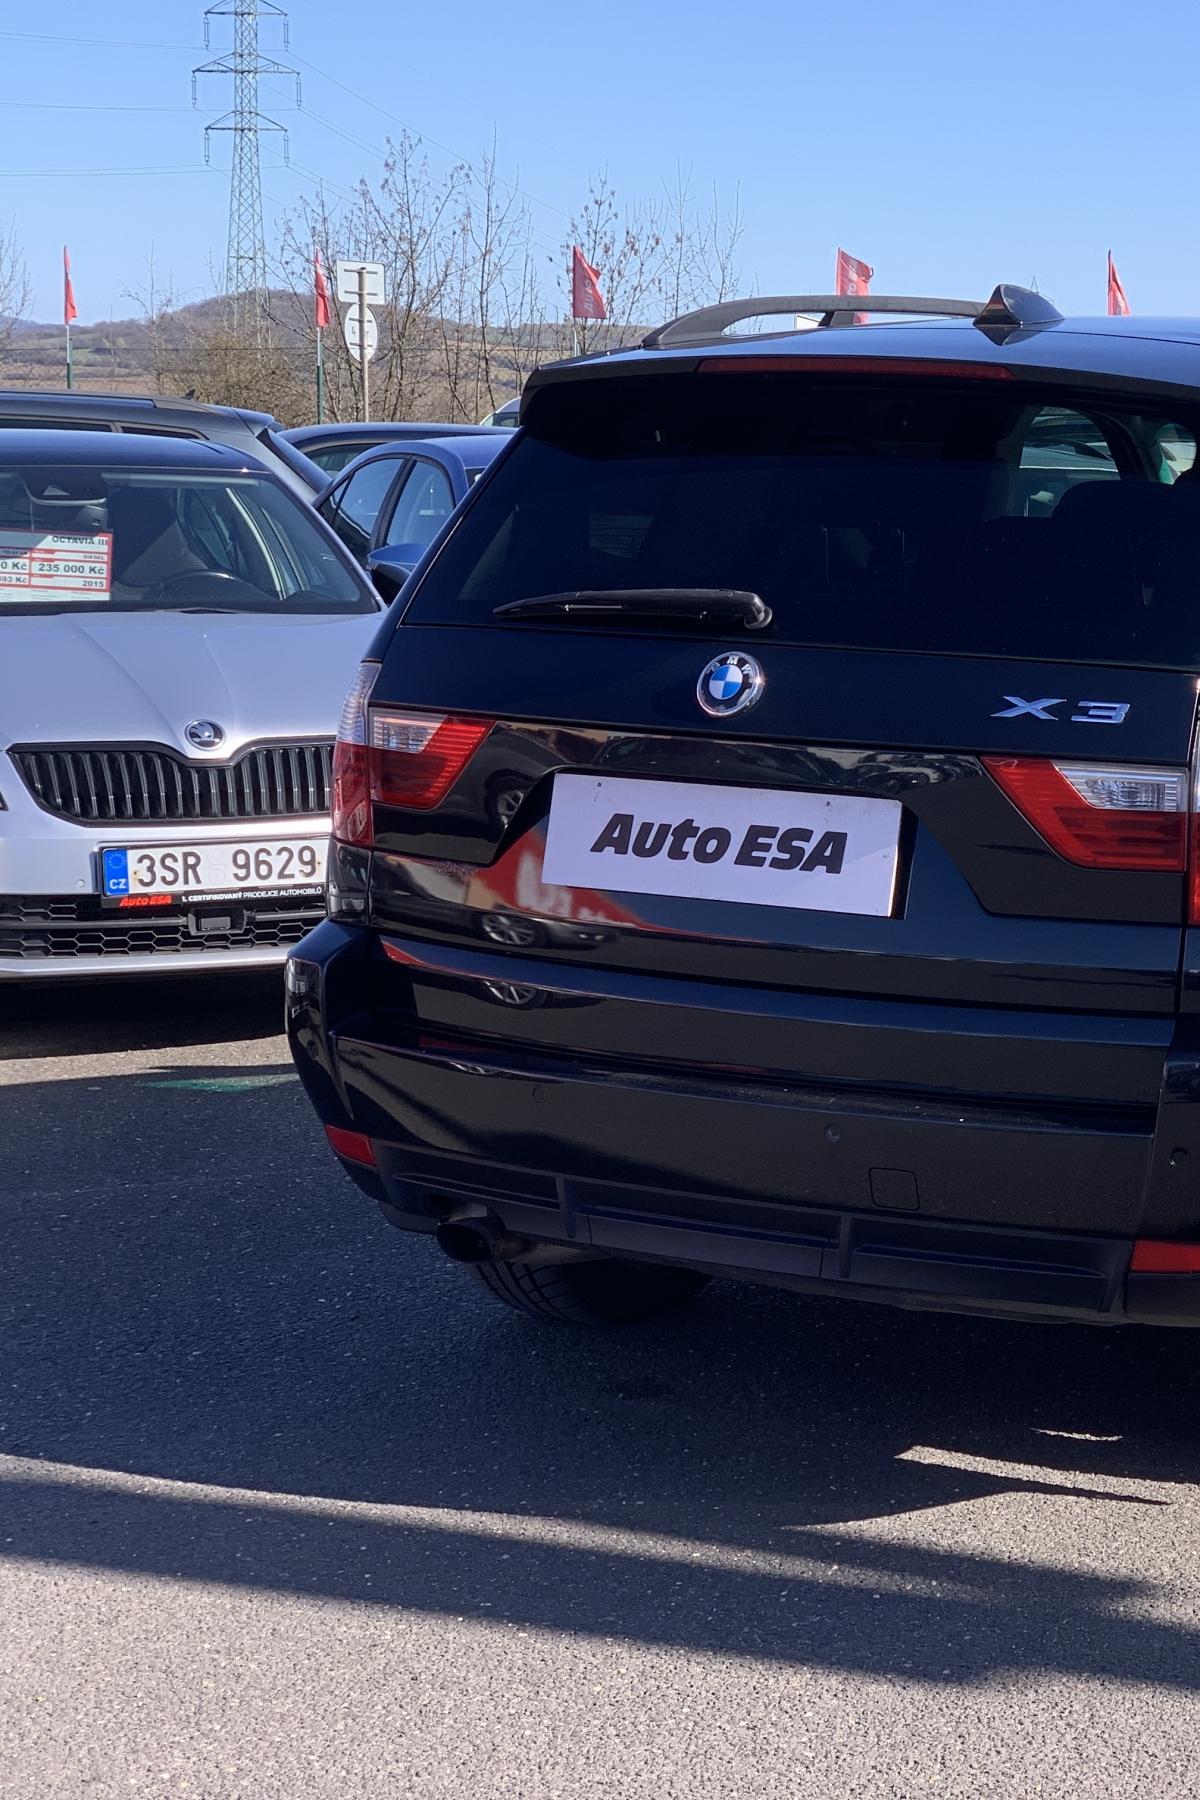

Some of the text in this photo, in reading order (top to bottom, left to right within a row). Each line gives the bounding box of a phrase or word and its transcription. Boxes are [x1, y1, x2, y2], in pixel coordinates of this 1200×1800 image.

[52, 535, 95, 545] OCTAVIA
[38, 563, 105, 575] 235 000 Kč
[82, 580, 105, 588] 2015
[590, 813, 848, 875] Auto ESA
[137, 845, 317, 887] 3SR 9629
[109, 878, 127, 890] CZ
[243, 889, 279, 899] PRODEJCE
[279, 886, 322, 897] AUTOMOBILŮ
